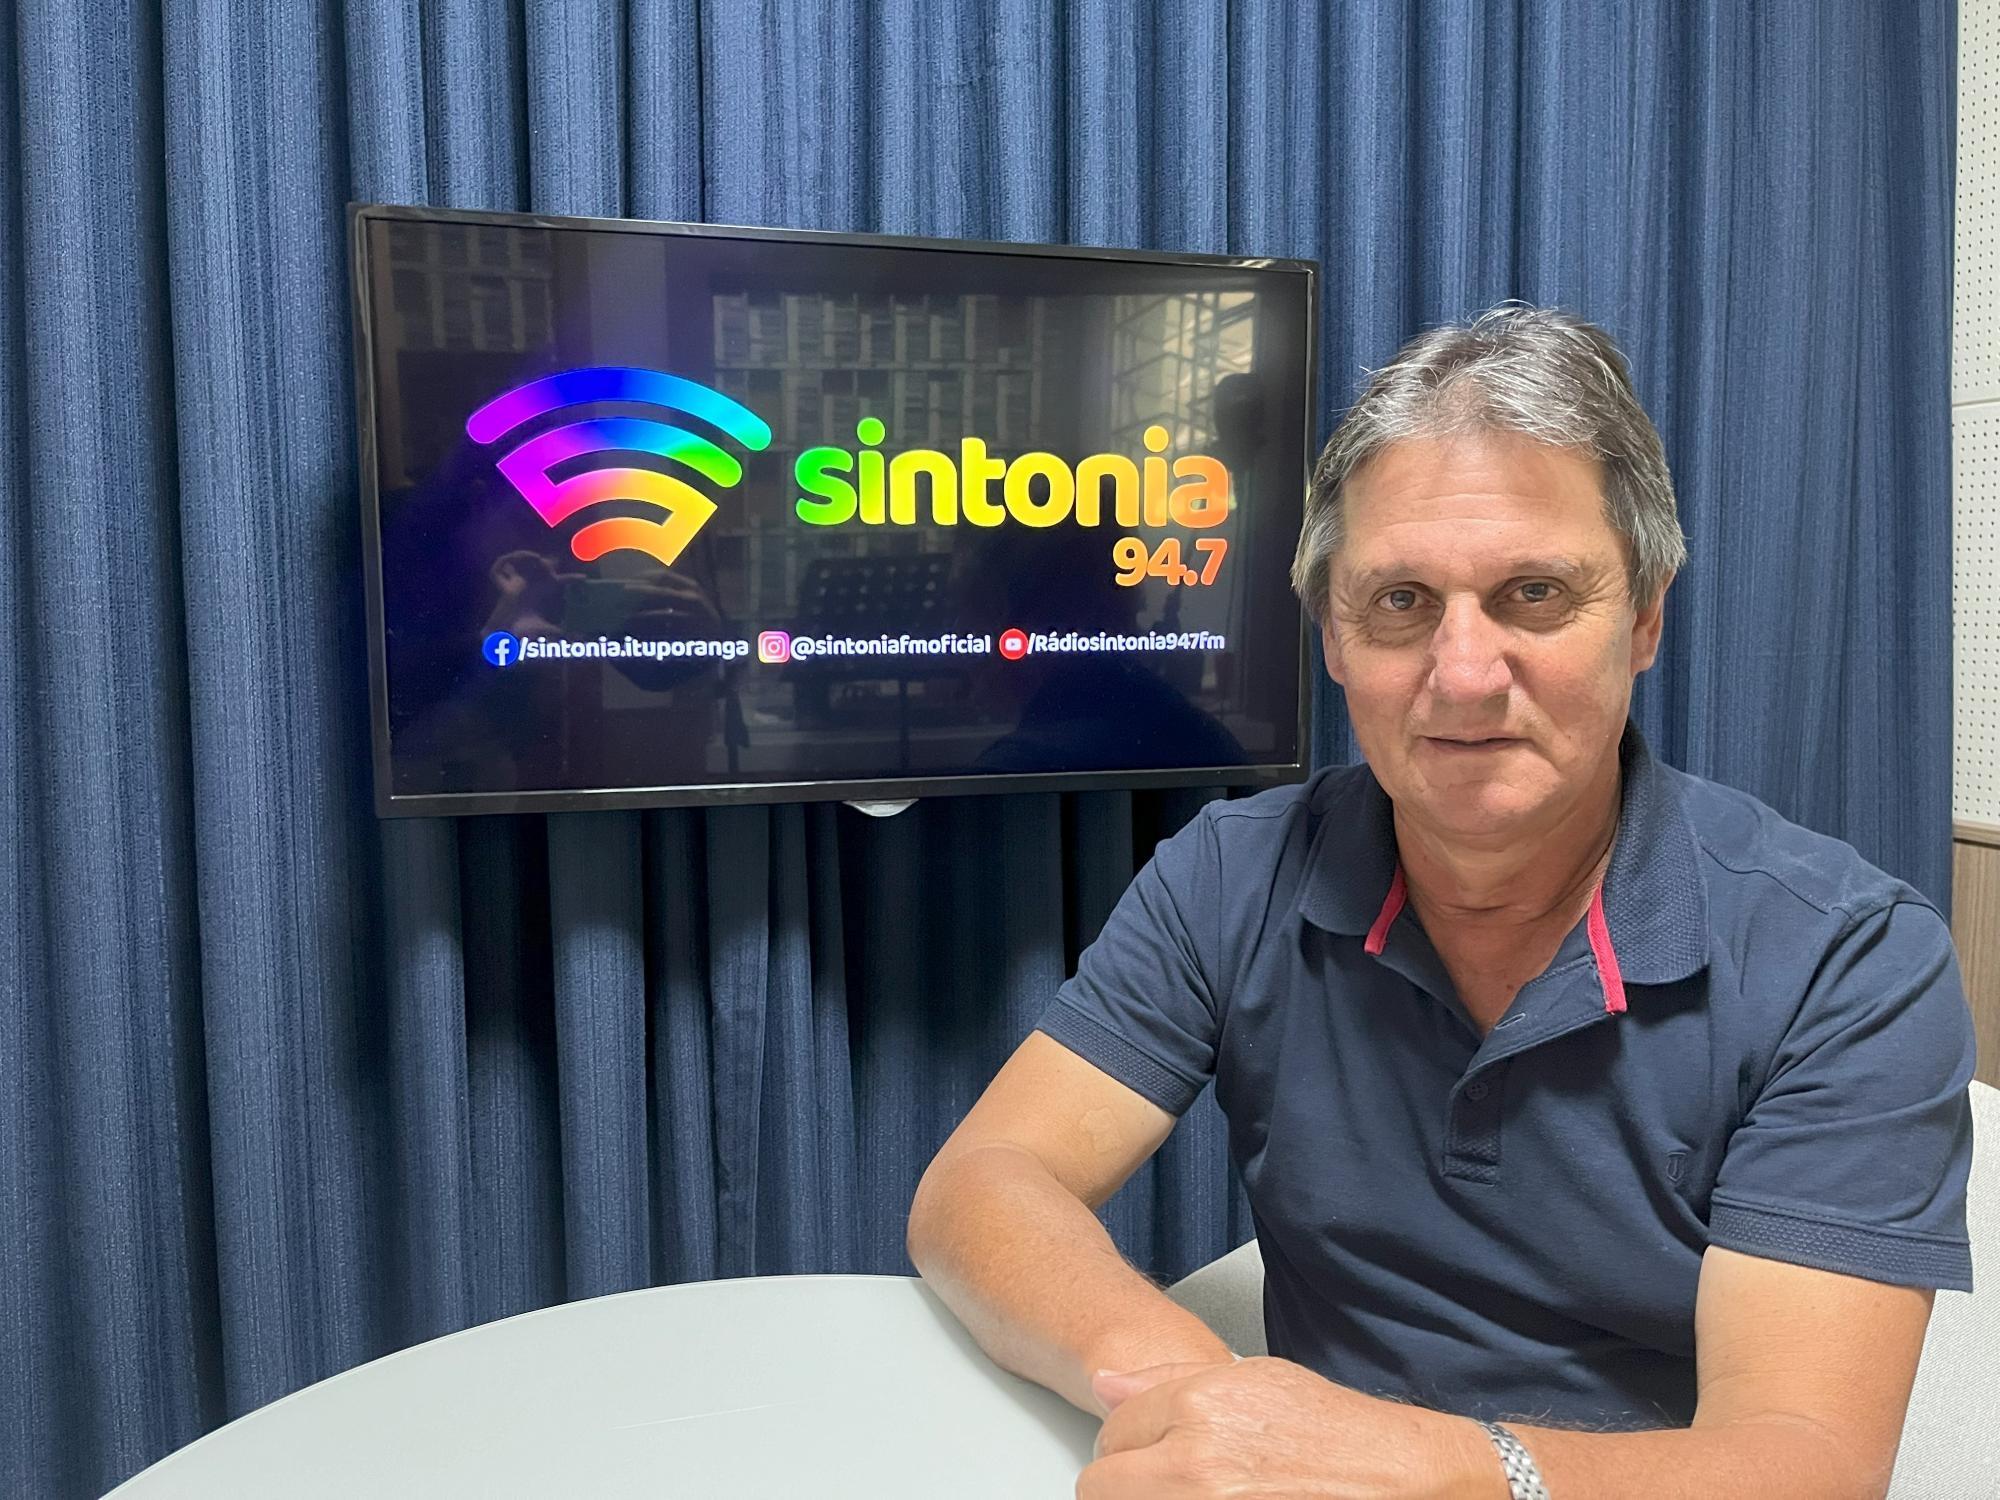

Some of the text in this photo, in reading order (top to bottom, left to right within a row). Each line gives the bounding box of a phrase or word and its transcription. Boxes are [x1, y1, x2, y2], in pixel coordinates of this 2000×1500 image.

[795, 417, 1229, 528] sintonia
[1112, 537, 1228, 587] 94.7
[518, 636, 749, 661] /sintonia.ituporanga
[790, 634, 991, 660] @sintoniafmoficial
[1027, 631, 1225, 653] /Rádiosintonia947fm
